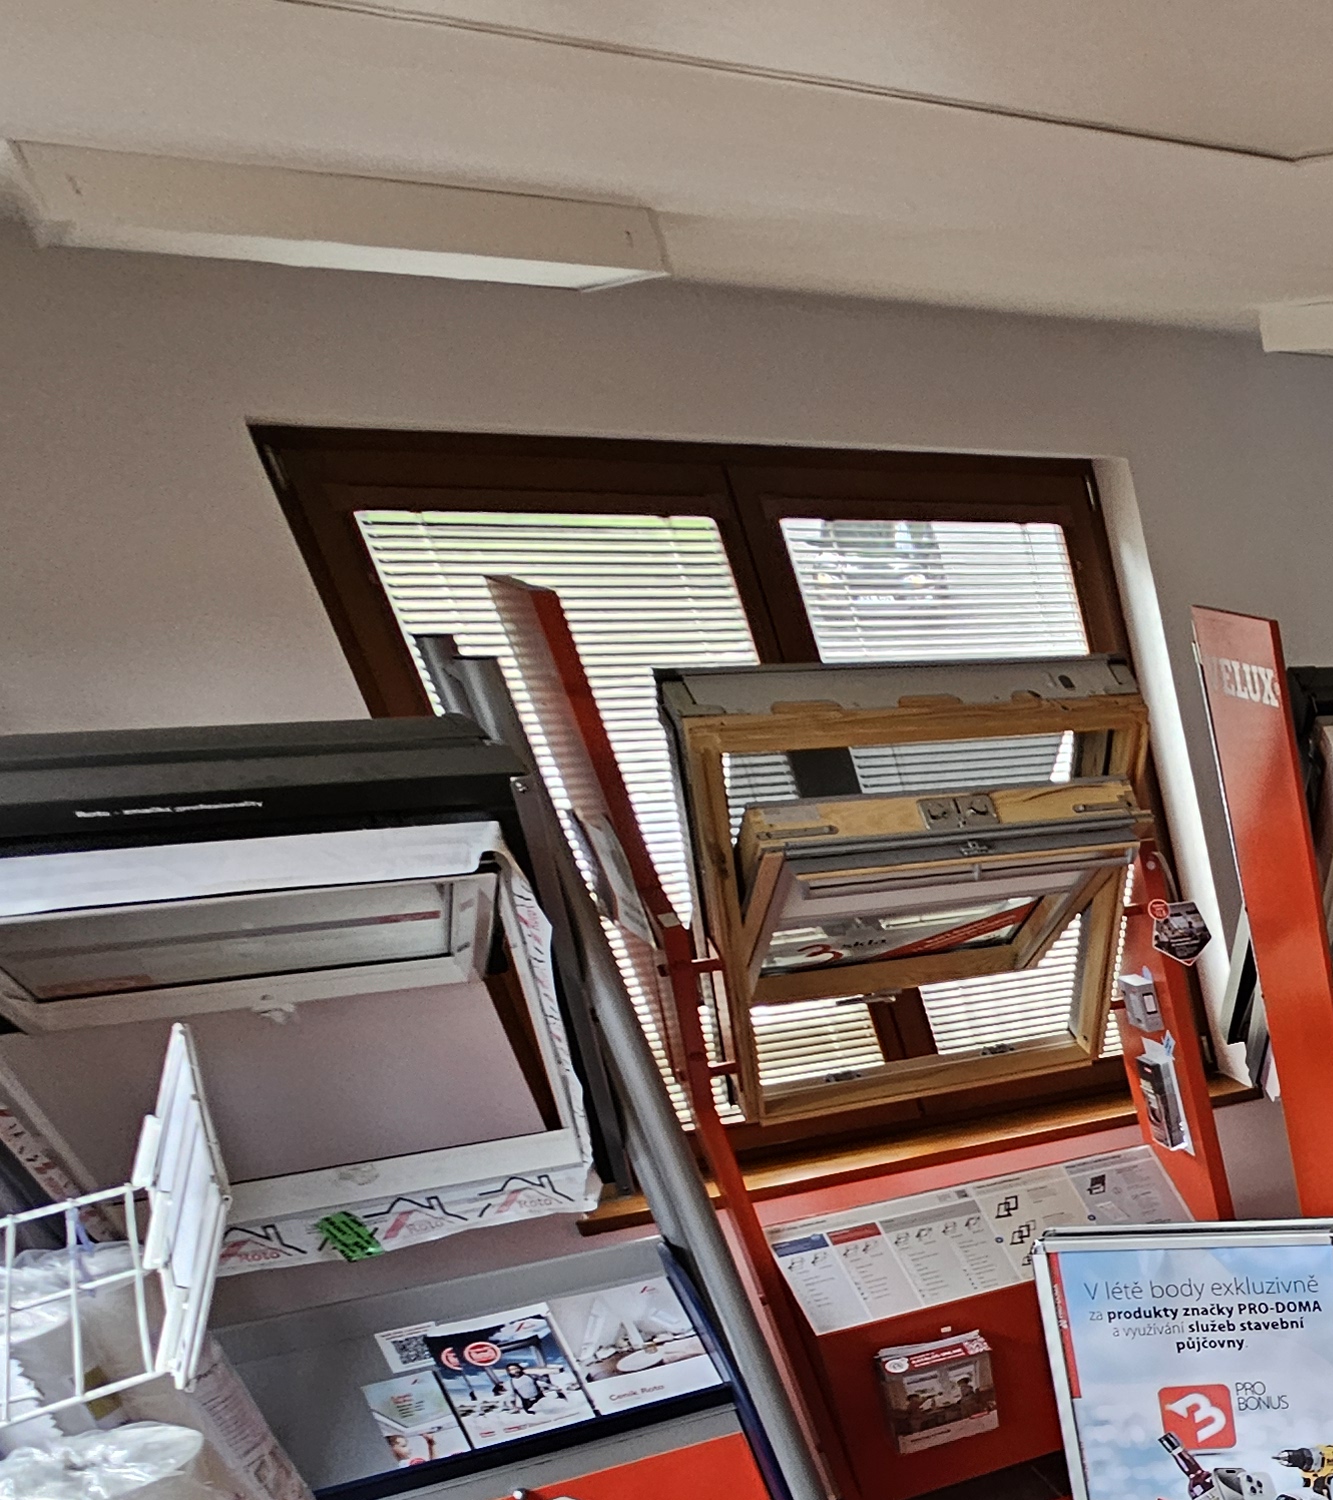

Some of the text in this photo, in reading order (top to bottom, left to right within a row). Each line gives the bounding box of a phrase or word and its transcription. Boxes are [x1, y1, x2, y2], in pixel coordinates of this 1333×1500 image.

[1084, 1274, 1319, 1302] V létě body exkluzivně
[1089, 1300, 1322, 1323] za produkty značky PRO-DOMA
[1123, 1322, 1185, 1339] využívání
[1188, 1318, 1236, 1334] služeb
[1240, 1316, 1304, 1331] stavební
[641, 1383, 664, 1396] Roto
[1235, 1381, 1266, 1396] PRO
[1238, 1395, 1289, 1411] BONUS
